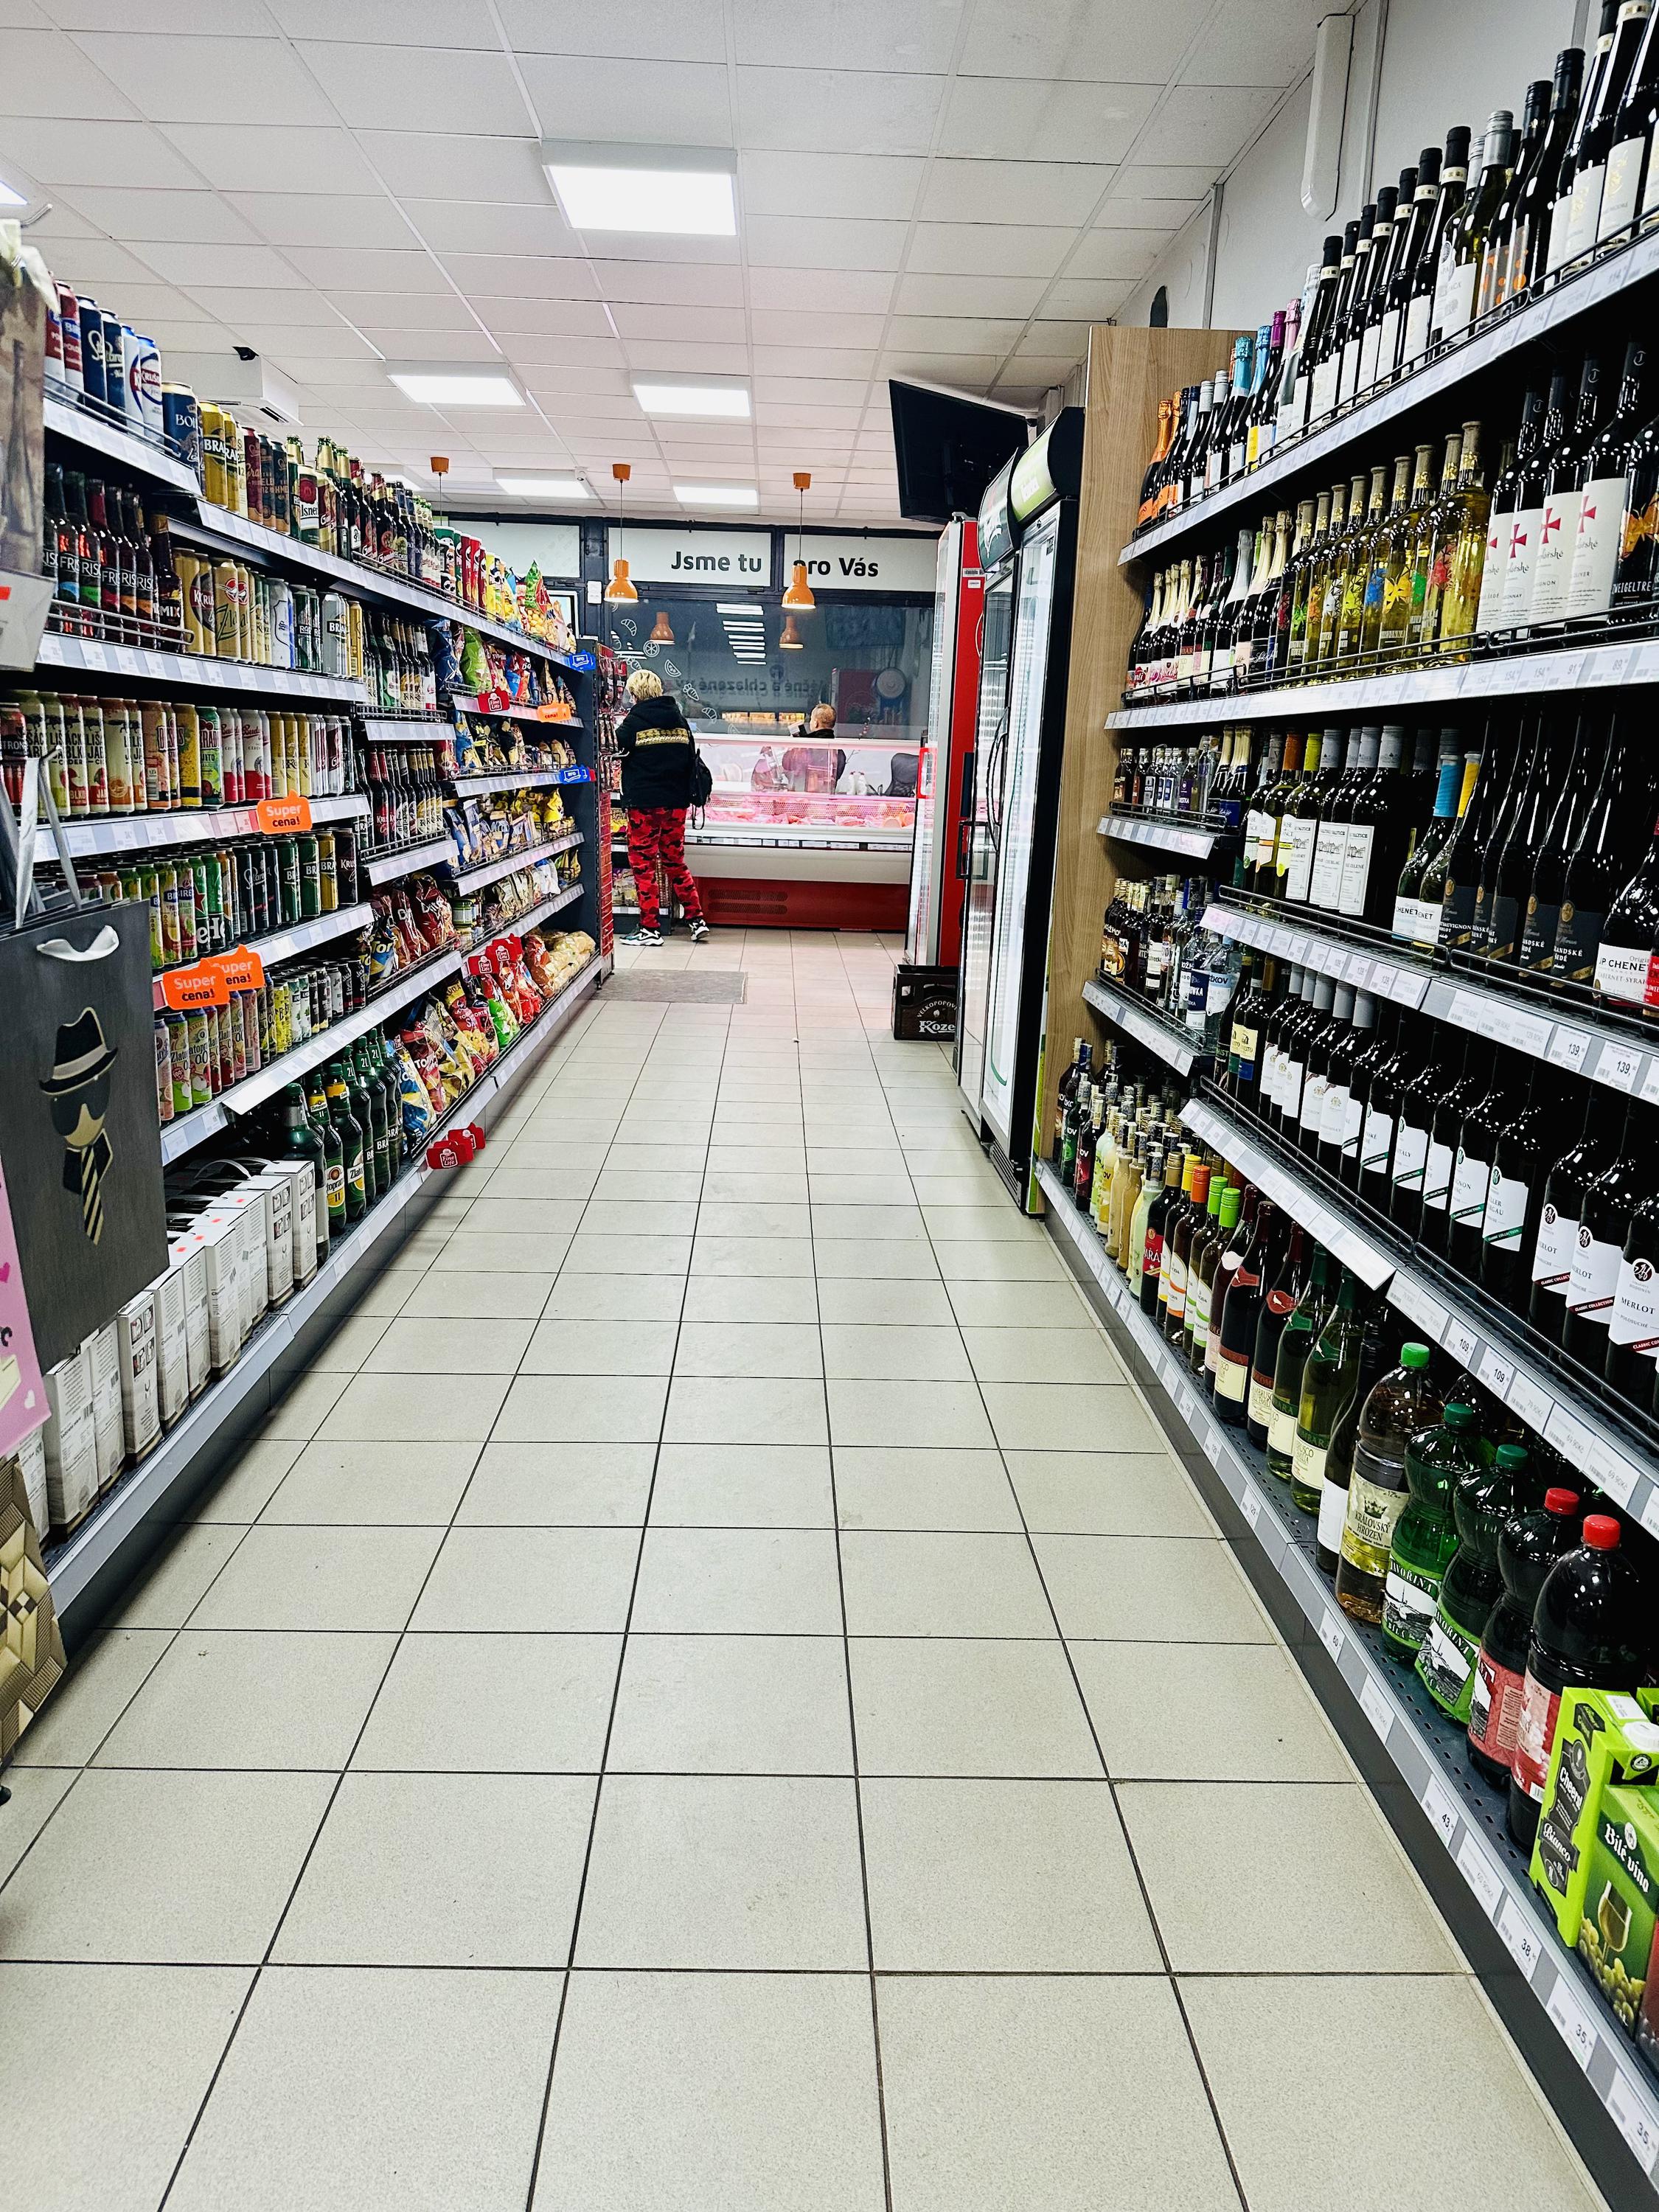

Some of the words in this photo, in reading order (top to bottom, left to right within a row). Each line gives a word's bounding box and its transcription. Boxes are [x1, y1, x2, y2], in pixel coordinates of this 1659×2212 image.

[671, 551, 731, 571] Jsme
[738, 554, 762, 572] tu
[839, 557, 879, 577] Vás
[266, 804, 301, 818] Super
[272, 815, 300, 827] cena!
[213, 960, 253, 975] uper
[1608, 959, 1649, 973] CHENE
[174, 975, 216, 990] Super
[225, 973, 252, 985] ena!
[182, 988, 215, 1001] cena!
[1621, 1297, 1655, 1315] MERLOT
[1357, 1523, 1382, 1542] HROZEN
[1544, 1823, 1571, 1862] Bianco
